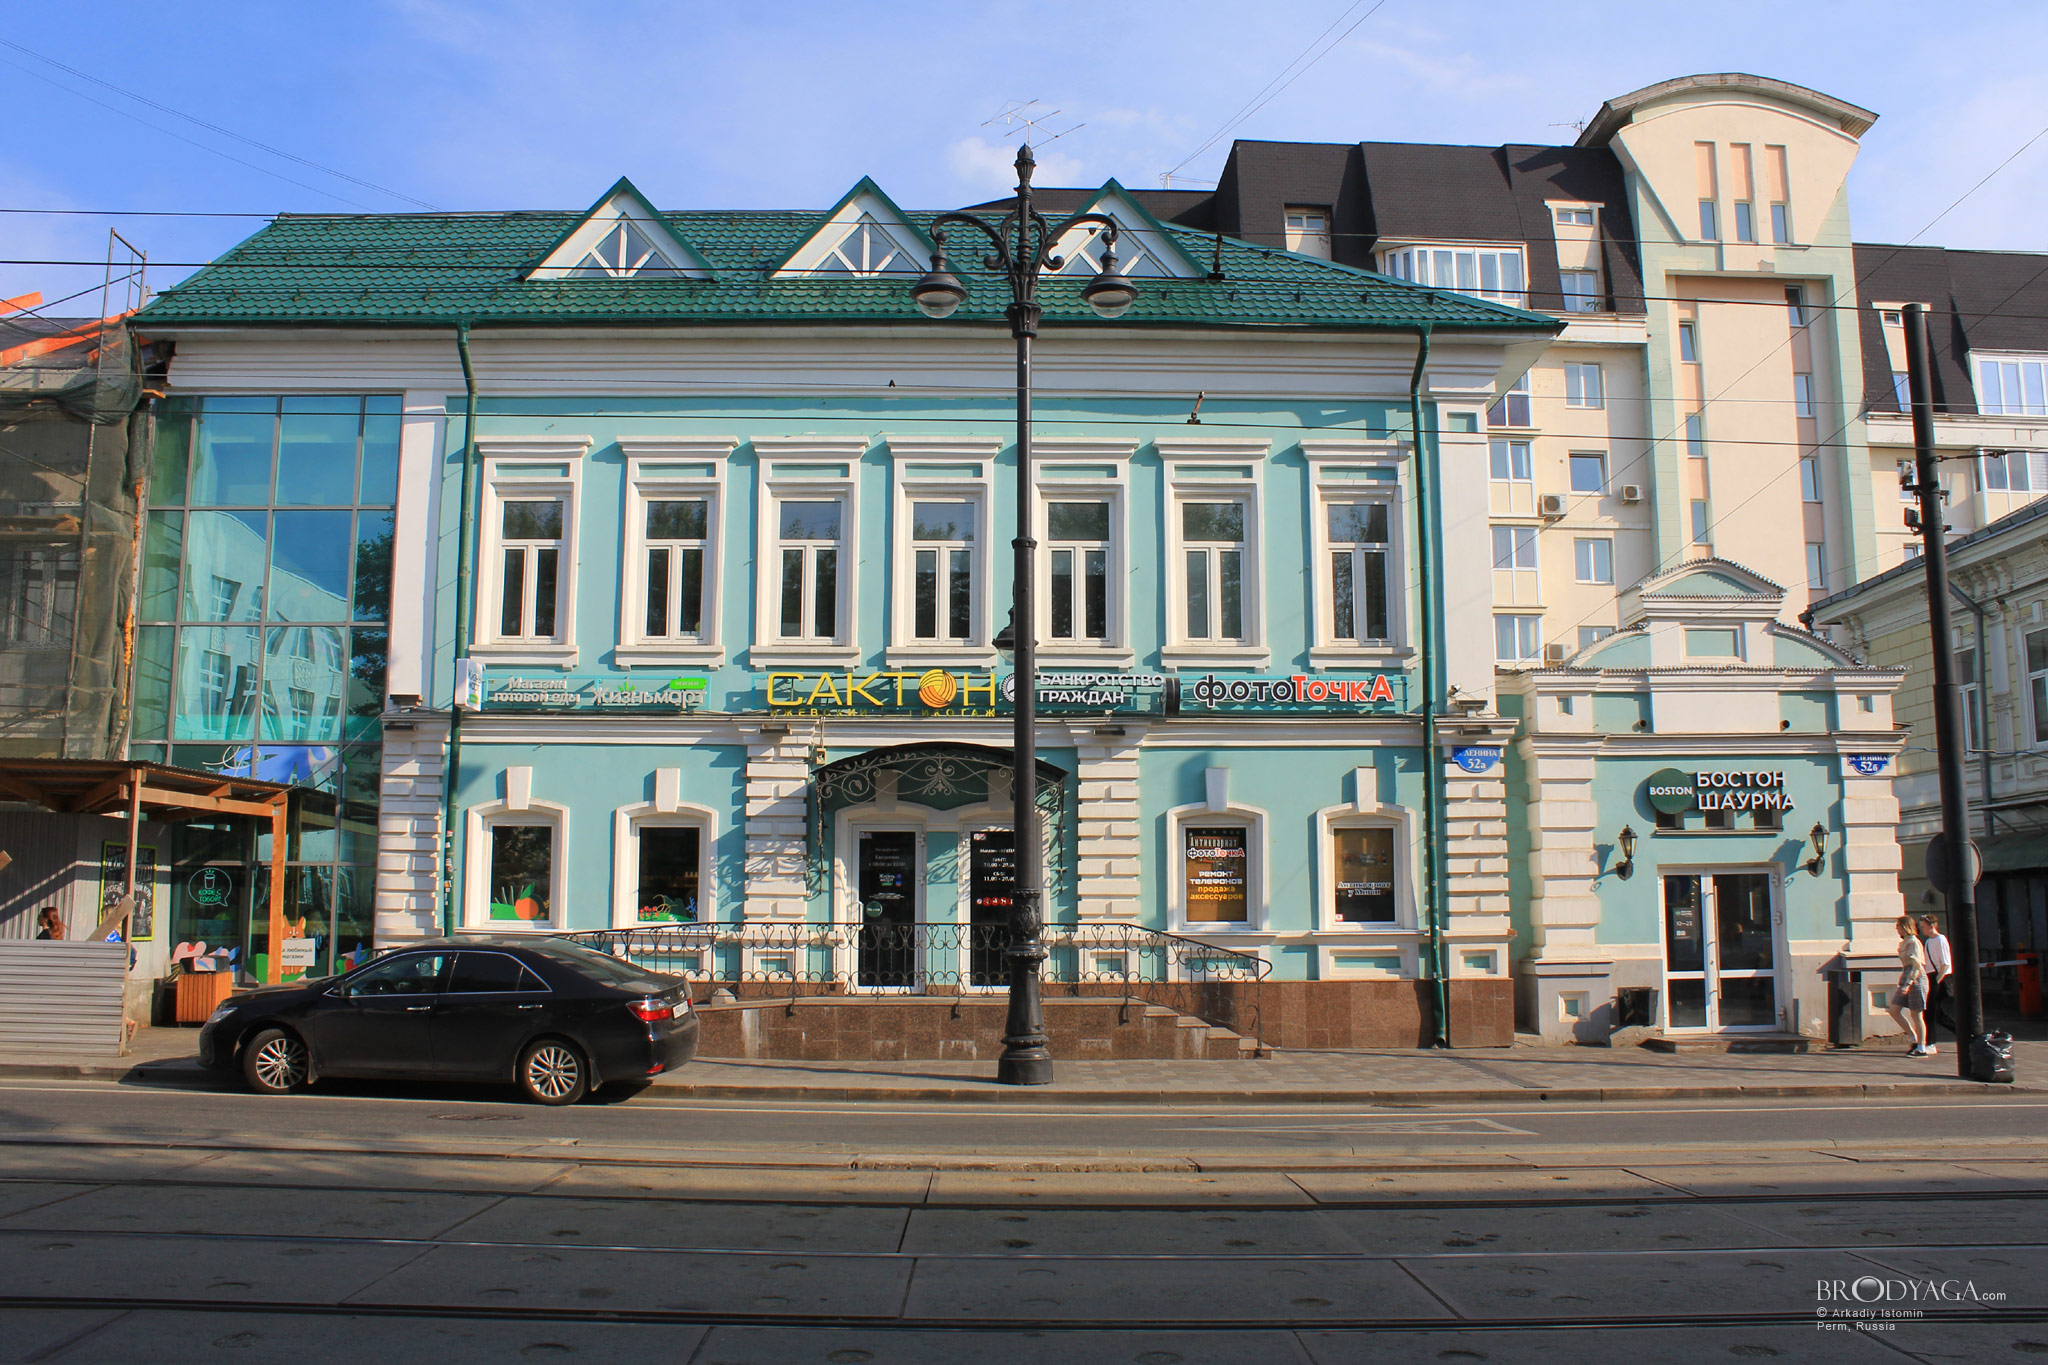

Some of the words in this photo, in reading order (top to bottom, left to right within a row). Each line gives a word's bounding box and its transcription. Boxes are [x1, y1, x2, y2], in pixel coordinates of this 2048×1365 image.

[508, 677, 568, 689] Магазин
[1039, 672, 1164, 687] БАНКРОТСТВО
[767, 668, 996, 708] САКТОН
[494, 689, 548, 702] готовой
[551, 692, 581, 706] еды
[591, 686, 707, 709] Жизньмарт
[1039, 690, 1125, 705] ГРАЖДАН
[1467, 758, 1487, 769] 52а
[1696, 771, 1785, 787] БОСТОН
[1649, 786, 1693, 796] BOSTON
[1697, 793, 1797, 810] ШАУРМА
